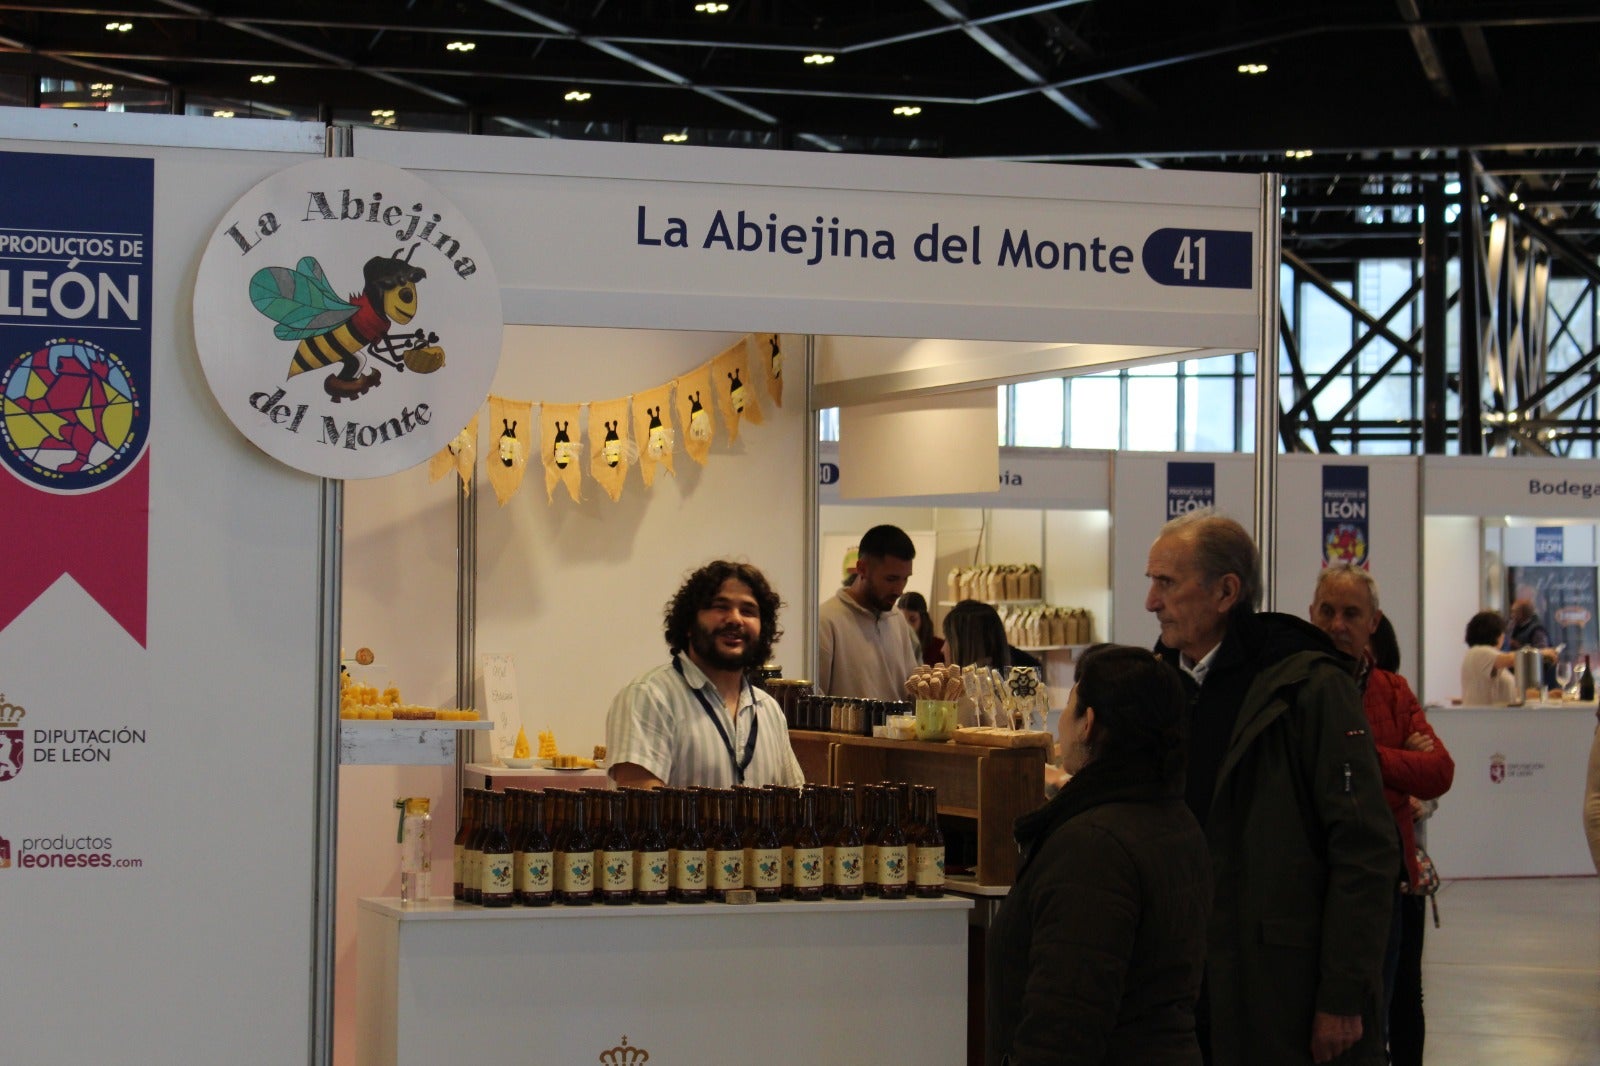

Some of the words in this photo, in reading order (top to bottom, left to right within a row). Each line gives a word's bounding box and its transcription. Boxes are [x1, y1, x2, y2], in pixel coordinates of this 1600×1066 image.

[224, 211, 282, 257] La
[301, 187, 478, 282] Abiejina
[637, 205, 689, 248] La
[702, 209, 896, 266] Abiejina
[913, 222, 982, 266] del
[997, 228, 1134, 275] Monte
[1173, 236, 1206, 281] 41
[0, 235, 115, 257] PRODUCTOS
[119, 239, 144, 258] DE
[0, 256, 139, 321] LEÓN
[248, 386, 309, 434] del
[319, 401, 433, 451] Monte
[998, 470, 1023, 486] ia
[1324, 497, 1366, 519] LEÓN
[33, 726, 147, 744] DIPUTACIÓN
[33, 748, 56, 763] DE
[62, 744, 111, 763] LEÓN
[22, 834, 113, 854] productos
